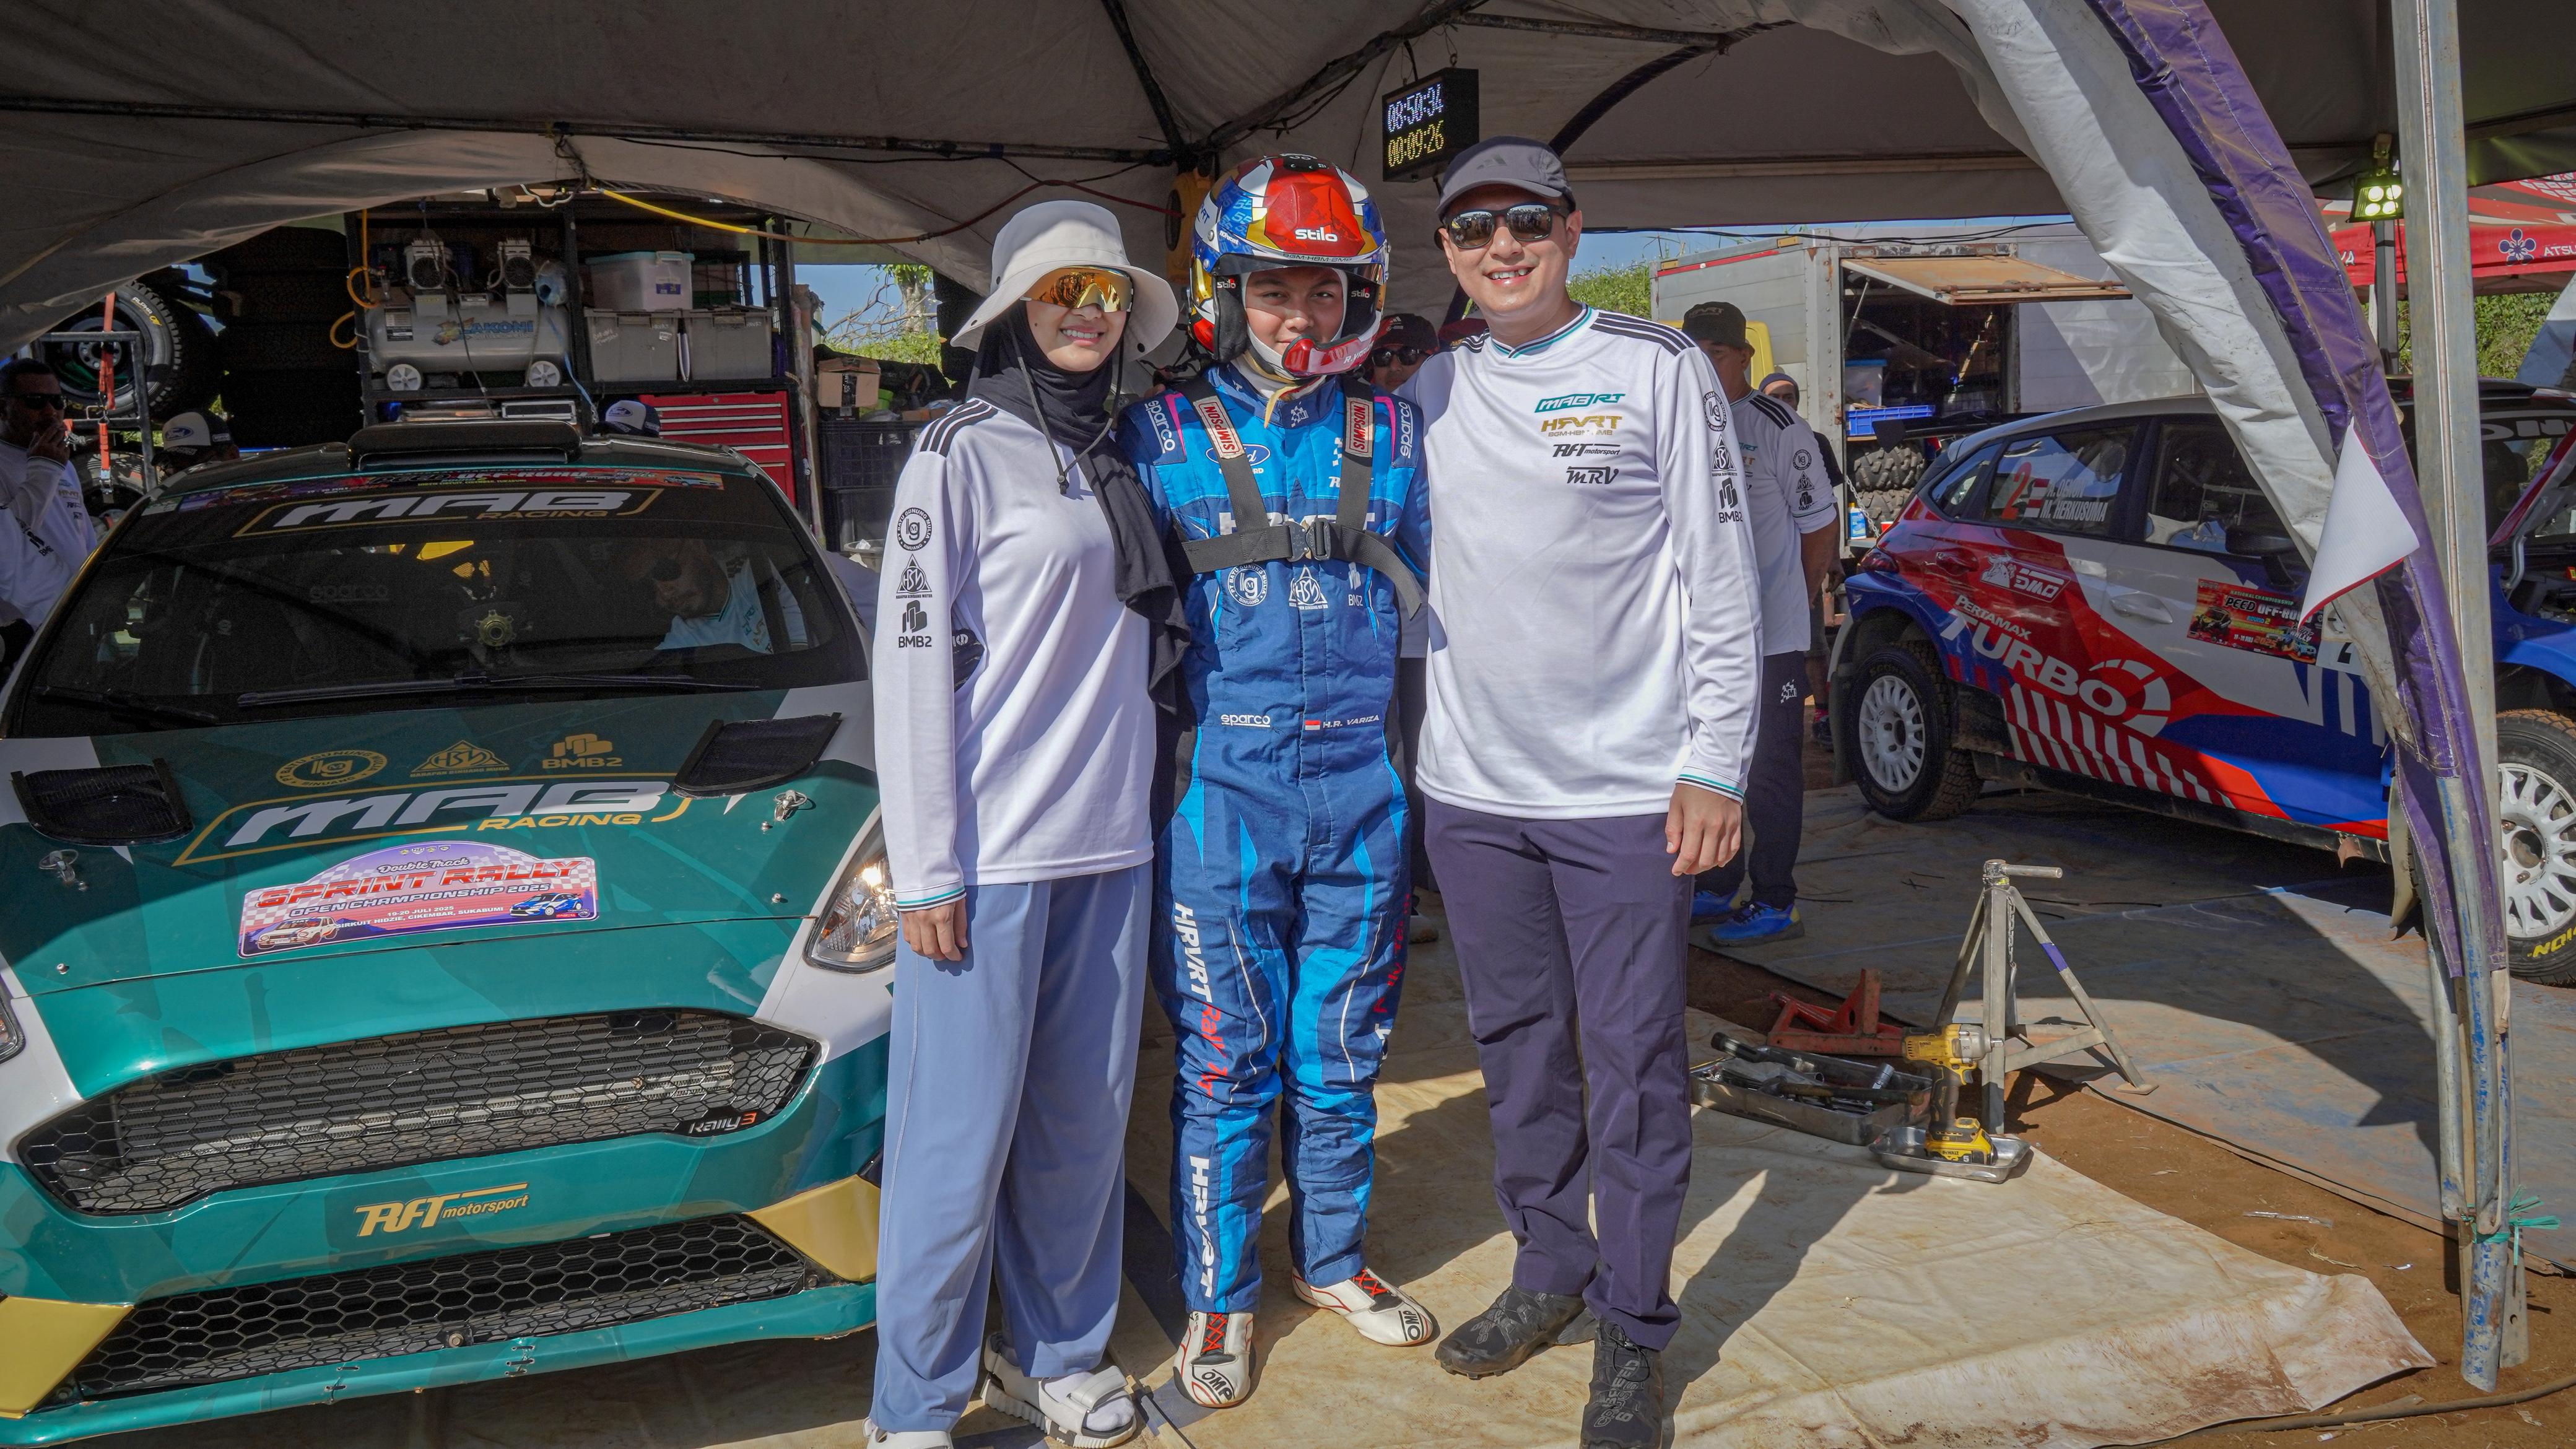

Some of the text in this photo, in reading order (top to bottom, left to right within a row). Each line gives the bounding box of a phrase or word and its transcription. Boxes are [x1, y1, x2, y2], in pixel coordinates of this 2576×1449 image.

[1387, 84, 1445, 133] 08:50:34
[1388, 121, 1444, 167] 00:09:26
[1294, 225, 1338, 242] Stilo
[1217, 279, 1237, 289] Stilo
[1351, 287, 1370, 299] Stilo
[1144, 400, 1176, 453] sparco
[1203, 406, 1235, 451] SIMPSON
[1352, 404, 1367, 450] SIMPSON
[1398, 401, 1414, 459] sparco
[2001, 461, 2032, 520] 2
[476, 510, 609, 520] RACING
[1718, 511, 1744, 524] BMB2
[1955, 594, 2032, 640] PERTAMAX
[898, 635, 933, 648] BMB2
[1940, 608, 2127, 716] TURBO
[1221, 713, 1271, 728] sparco
[1322, 714, 1380, 729] H.R. VARIZA
[281, 759, 305, 774] BATU
[310, 751, 373, 760] GUNUNG
[542, 757, 623, 770] BMB2
[301, 776, 356, 786] BINUANG
[476, 812, 642, 832] RACING
[377, 857, 470, 874] Double Track
[256, 860, 583, 908] SPRINT RALLY
[289, 883, 552, 918] OPEN CHAMPIONSHIP 2025
[335, 907, 503, 929] SIRKUIT HIDZIE, CIKEMBAR, SUKABUMI
[1174, 902, 1213, 1003] HRVRT
[1963, 1155, 1970, 1163] 5
[441, 1194, 529, 1219] motorsport
[1405, 1309, 1421, 1342] OMP
[1201, 1371, 1232, 1401] OMP
